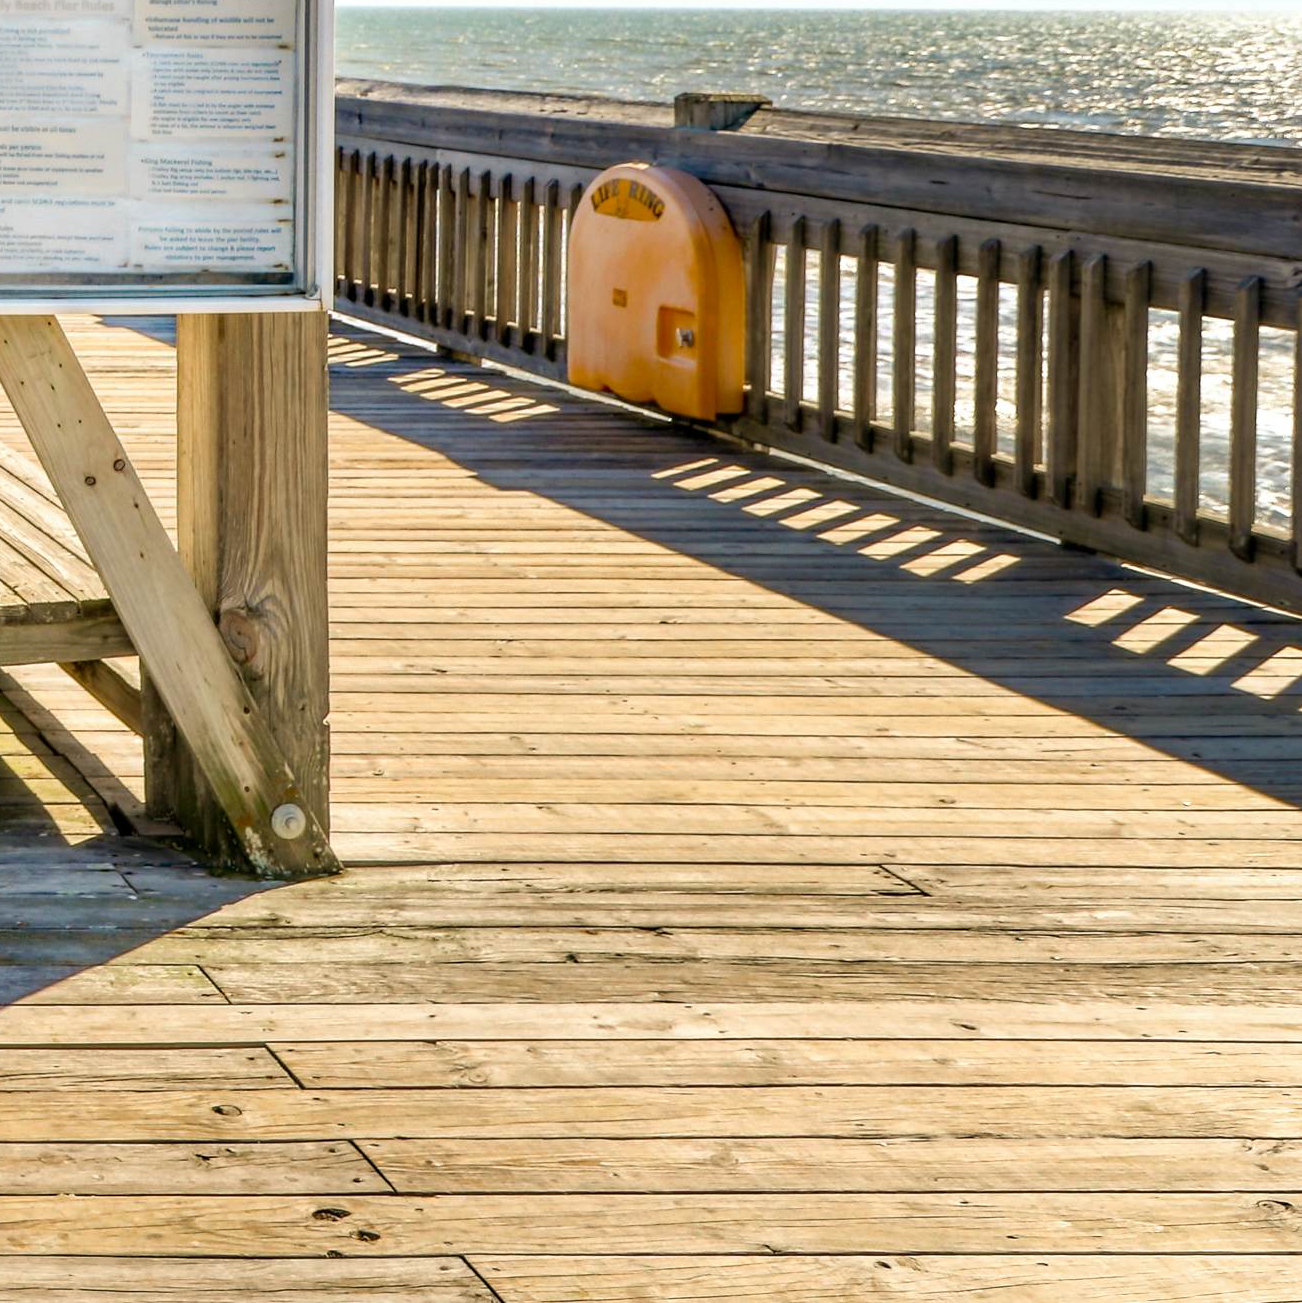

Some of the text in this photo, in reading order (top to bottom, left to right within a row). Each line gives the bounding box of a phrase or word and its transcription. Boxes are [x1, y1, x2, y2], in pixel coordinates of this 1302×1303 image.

[15, 0, 50, 11] Beach
[54, 0, 81, 11] Pier
[82, 0, 115, 11] Rules
[591, 179, 666, 219] LIFE RING
